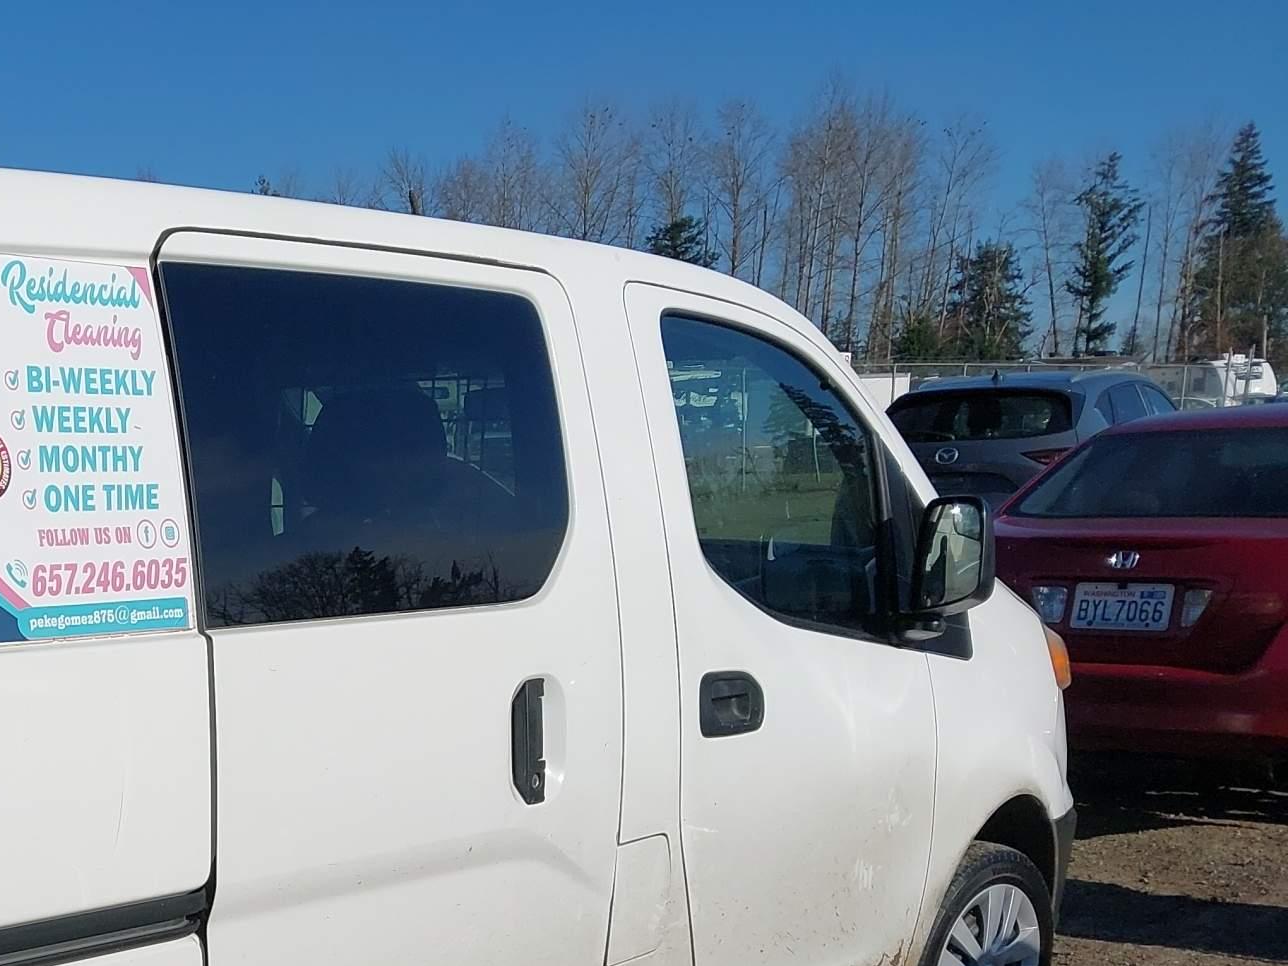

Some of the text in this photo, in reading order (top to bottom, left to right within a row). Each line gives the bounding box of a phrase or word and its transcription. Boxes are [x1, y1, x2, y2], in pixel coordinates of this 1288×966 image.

[1, 260, 141, 314] Residencial
[44, 310, 142, 361] Cleaning
[26, 365, 156, 396] BI-WEEKLY
[32, 405, 131, 434] WEEKLY
[39, 445, 143, 473] MONTHY
[44, 483, 160, 513] ONE TIME
[37, 527, 90, 548] FOLLOW
[93, 527, 111, 545] US
[115, 526, 132, 544] ON
[31, 558, 187, 597] 657.246.6035
[29, 605, 184, 631] pekegomez875@gmail.com
[1077, 599, 1165, 623] BYL7066
